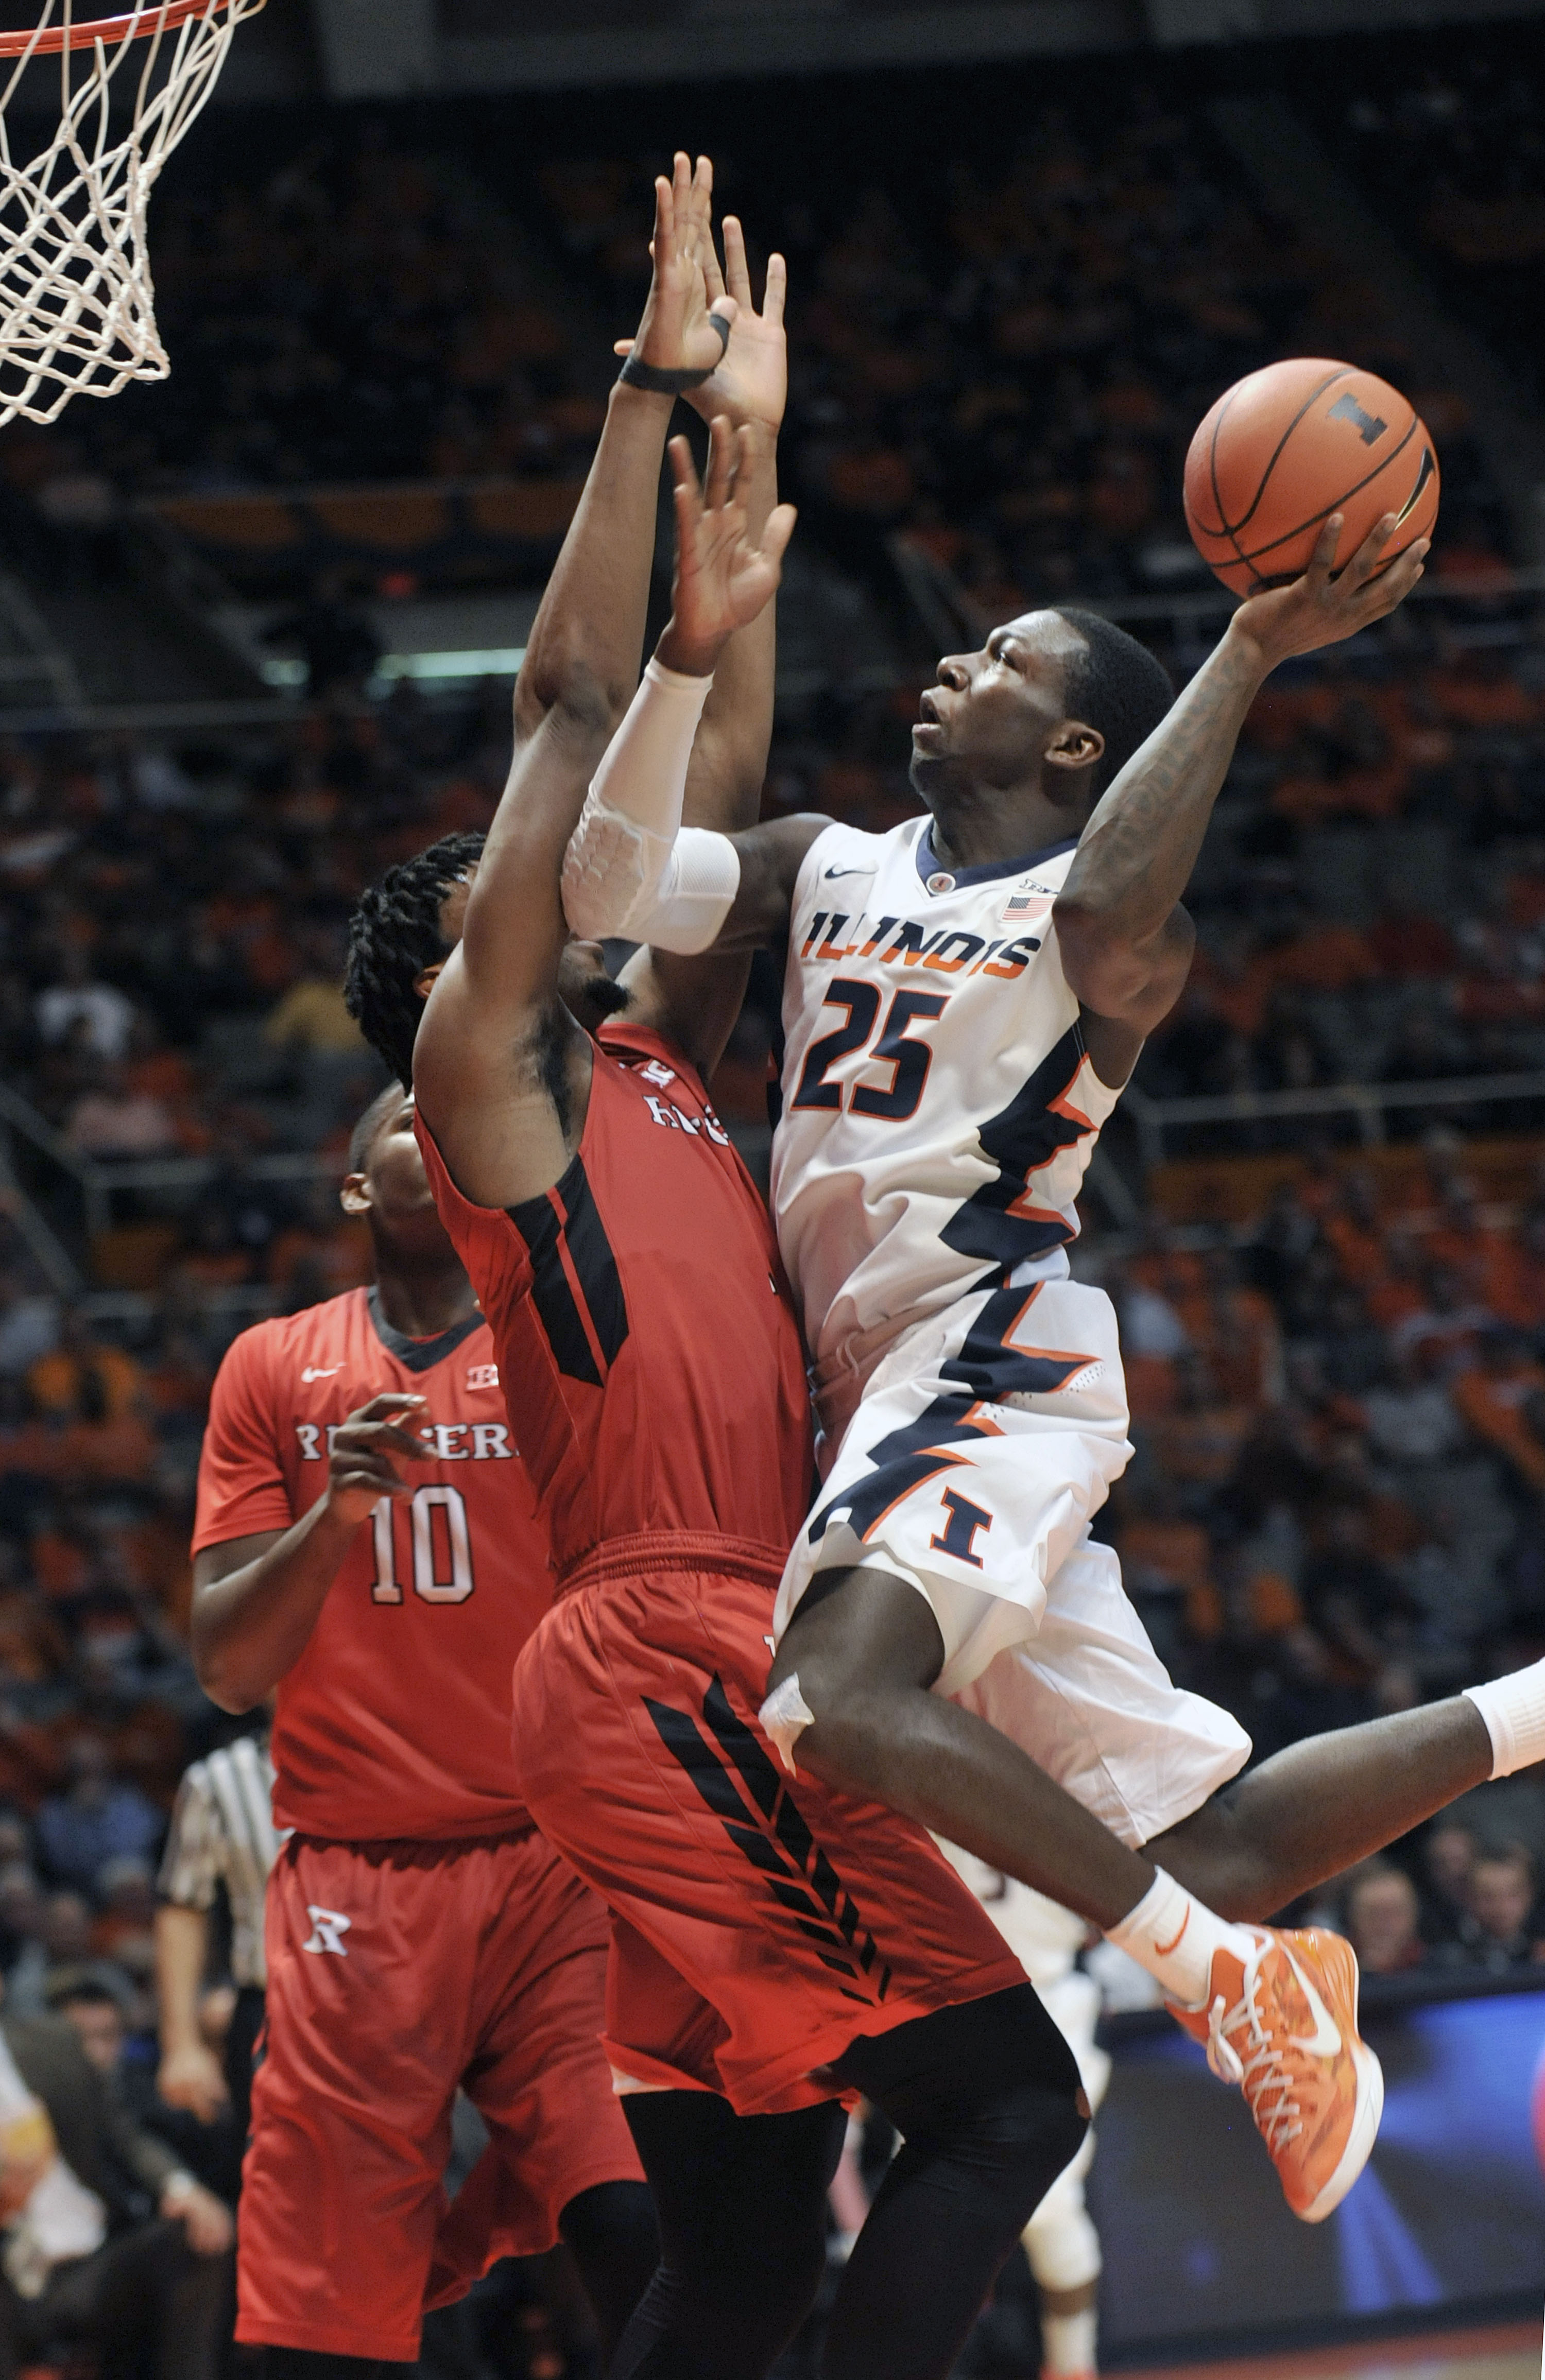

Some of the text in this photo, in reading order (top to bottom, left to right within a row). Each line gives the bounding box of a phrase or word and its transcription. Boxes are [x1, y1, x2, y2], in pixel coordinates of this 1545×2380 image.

[791, 976, 953, 1123] 25
[369, 1483, 475, 1606] 10
[929, 1486, 993, 1570] I
[302, 1904, 352, 1957] R
